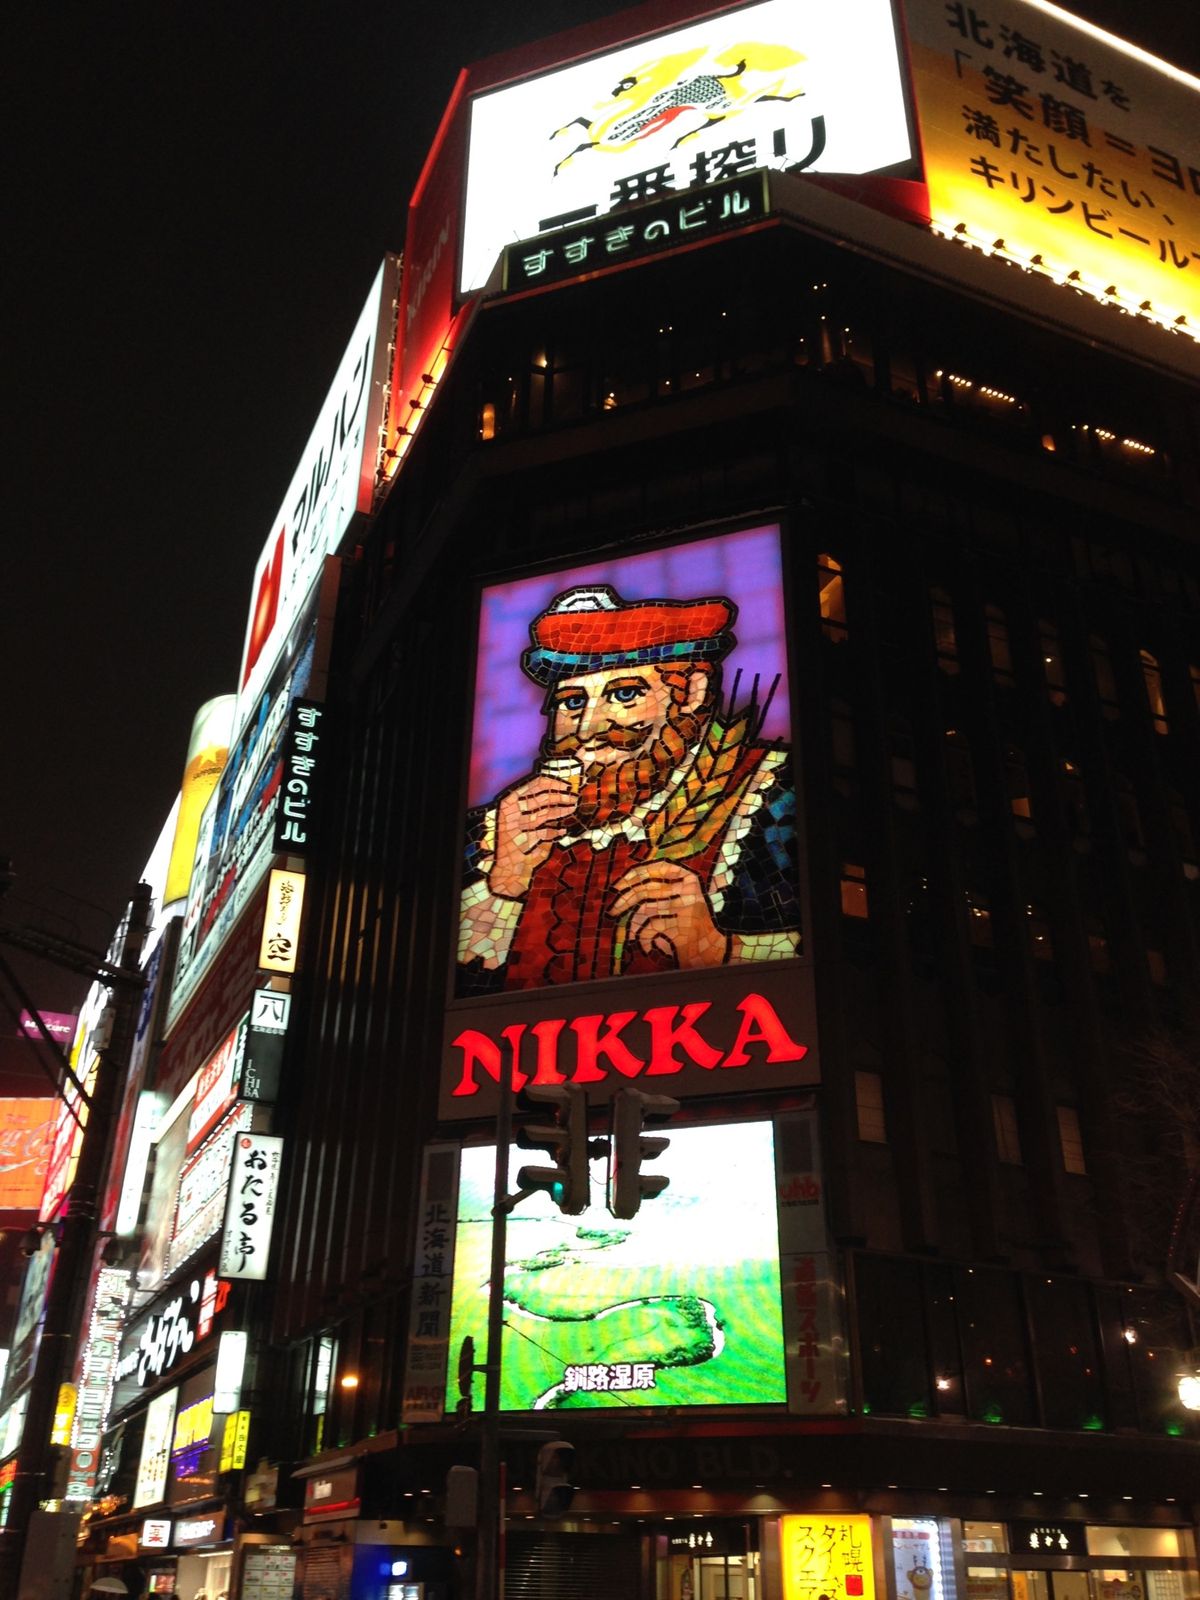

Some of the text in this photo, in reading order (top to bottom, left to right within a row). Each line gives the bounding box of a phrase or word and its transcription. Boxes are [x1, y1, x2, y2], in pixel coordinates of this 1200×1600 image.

[946, 3, 1131, 112] 北海道を
[522, 190, 751, 278] すすきのビル
[292, 334, 371, 557] マルハン
[450, 993, 808, 1097] NIKKA
[415, 1203, 452, 1339] 北海道新聞
[564, 1362, 656, 1392] 釧路湿原
